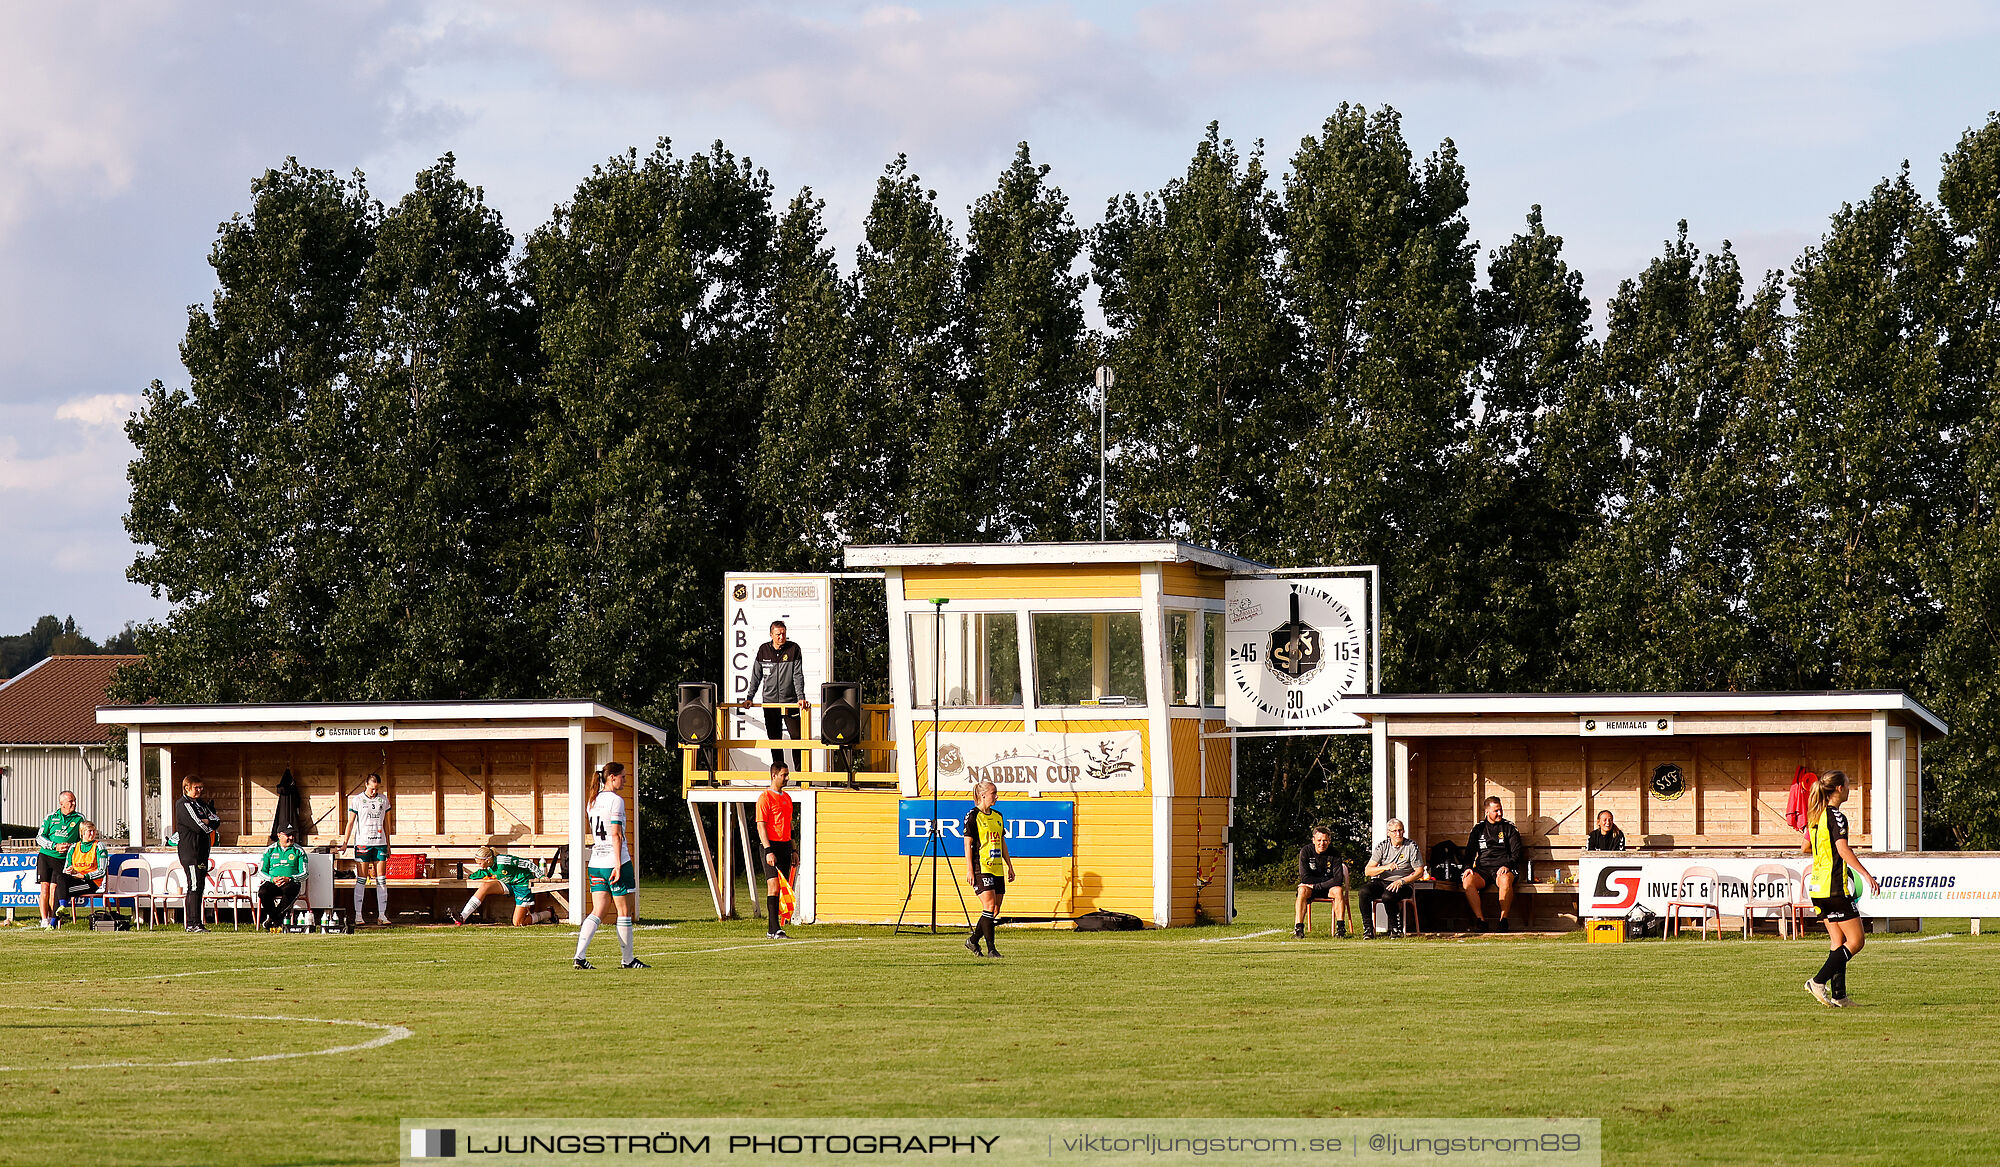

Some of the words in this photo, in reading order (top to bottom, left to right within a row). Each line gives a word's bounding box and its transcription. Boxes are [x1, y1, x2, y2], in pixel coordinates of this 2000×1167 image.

[756, 586, 782, 599] JON
[732, 608, 748, 626] A
[735, 630, 747, 648] B
[1240, 642, 1257, 662] 45
[1333, 641, 1350, 661] 15
[732, 652, 748, 671] C
[735, 675, 749, 693] D
[1287, 689, 1304, 709] 30
[363, 728, 376, 736] LAG
[736, 720, 746, 738] F
[1606, 721, 1647, 729] HEMMALAG
[967, 765, 1038, 784] NABBEN
[1046, 765, 1081, 784] CUP
[906, 818, 1068, 840] BRNDT
[0, 856, 19, 867] AR
[1647, 882, 1695, 898] INVEST
[1700, 882, 1709, 898] &
[1713, 882, 1793, 898] TRANSPORT
[1900, 891, 1943, 900] ELHANDEL
